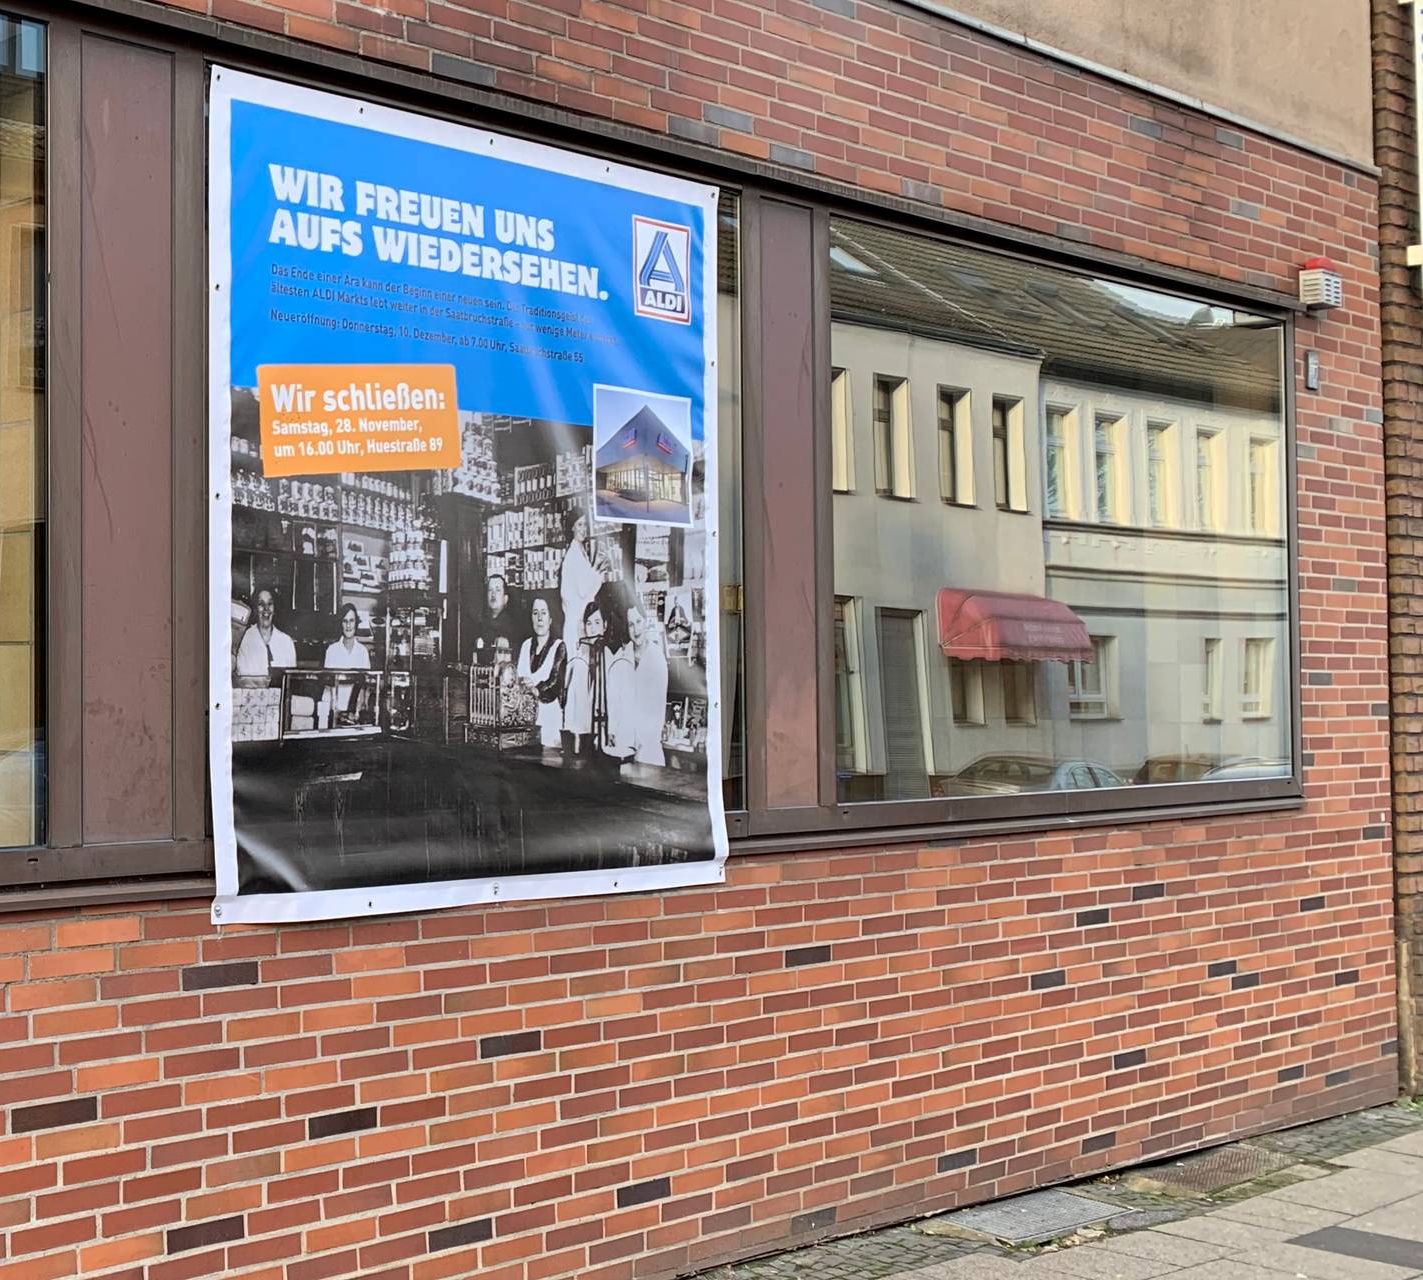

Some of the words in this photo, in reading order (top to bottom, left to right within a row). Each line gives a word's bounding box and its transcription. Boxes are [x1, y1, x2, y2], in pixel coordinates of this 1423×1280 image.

[269, 163, 344, 212] WIR
[355, 181, 484, 238] FREUEN
[494, 209, 555, 252] UNS
[268, 208, 363, 257] AUFS
[373, 225, 609, 301] WIEDERSEHEN.
[271, 263, 289, 277] Das
[291, 267, 314, 281] Ende
[317, 271, 342, 285] einer
[362, 277, 383, 290] kann
[385, 281, 401, 293] der
[403, 284, 432, 299] Beginn
[434, 289, 456, 302] einer
[458, 292, 483, 306] neuen
[484, 297, 505, 310] sein.
[644, 291, 682, 311] ALDI
[271, 281, 309, 298] ältesten
[312, 287, 335, 300] ALDI
[337, 292, 368, 307] Markts
[370, 296, 388, 309] lebt
[390, 301, 417, 313] weiter
[419, 303, 428, 314] in
[429, 305, 444, 317] der
[445, 307, 514, 329] Saatbruchstraße
[535, 322, 564, 338] wenige
[271, 308, 340, 330] Neueröffnung:
[342, 318, 397, 338] Donnerstag,
[399, 325, 411, 338] 10.
[459, 335, 470, 347] ab
[471, 337, 488, 350] 7.00
[270, 383, 317, 413] Wir
[323, 382, 446, 412] schließen:
[272, 419, 333, 437] Samstag,
[335, 418, 356, 433] 28.
[358, 417, 422, 434] November,
[274, 444, 295, 457] um
[298, 441, 333, 456] 16.00
[337, 439, 364, 457] Uhr,
[367, 437, 427, 453] Huestraße
[429, 437, 443, 452] 89
